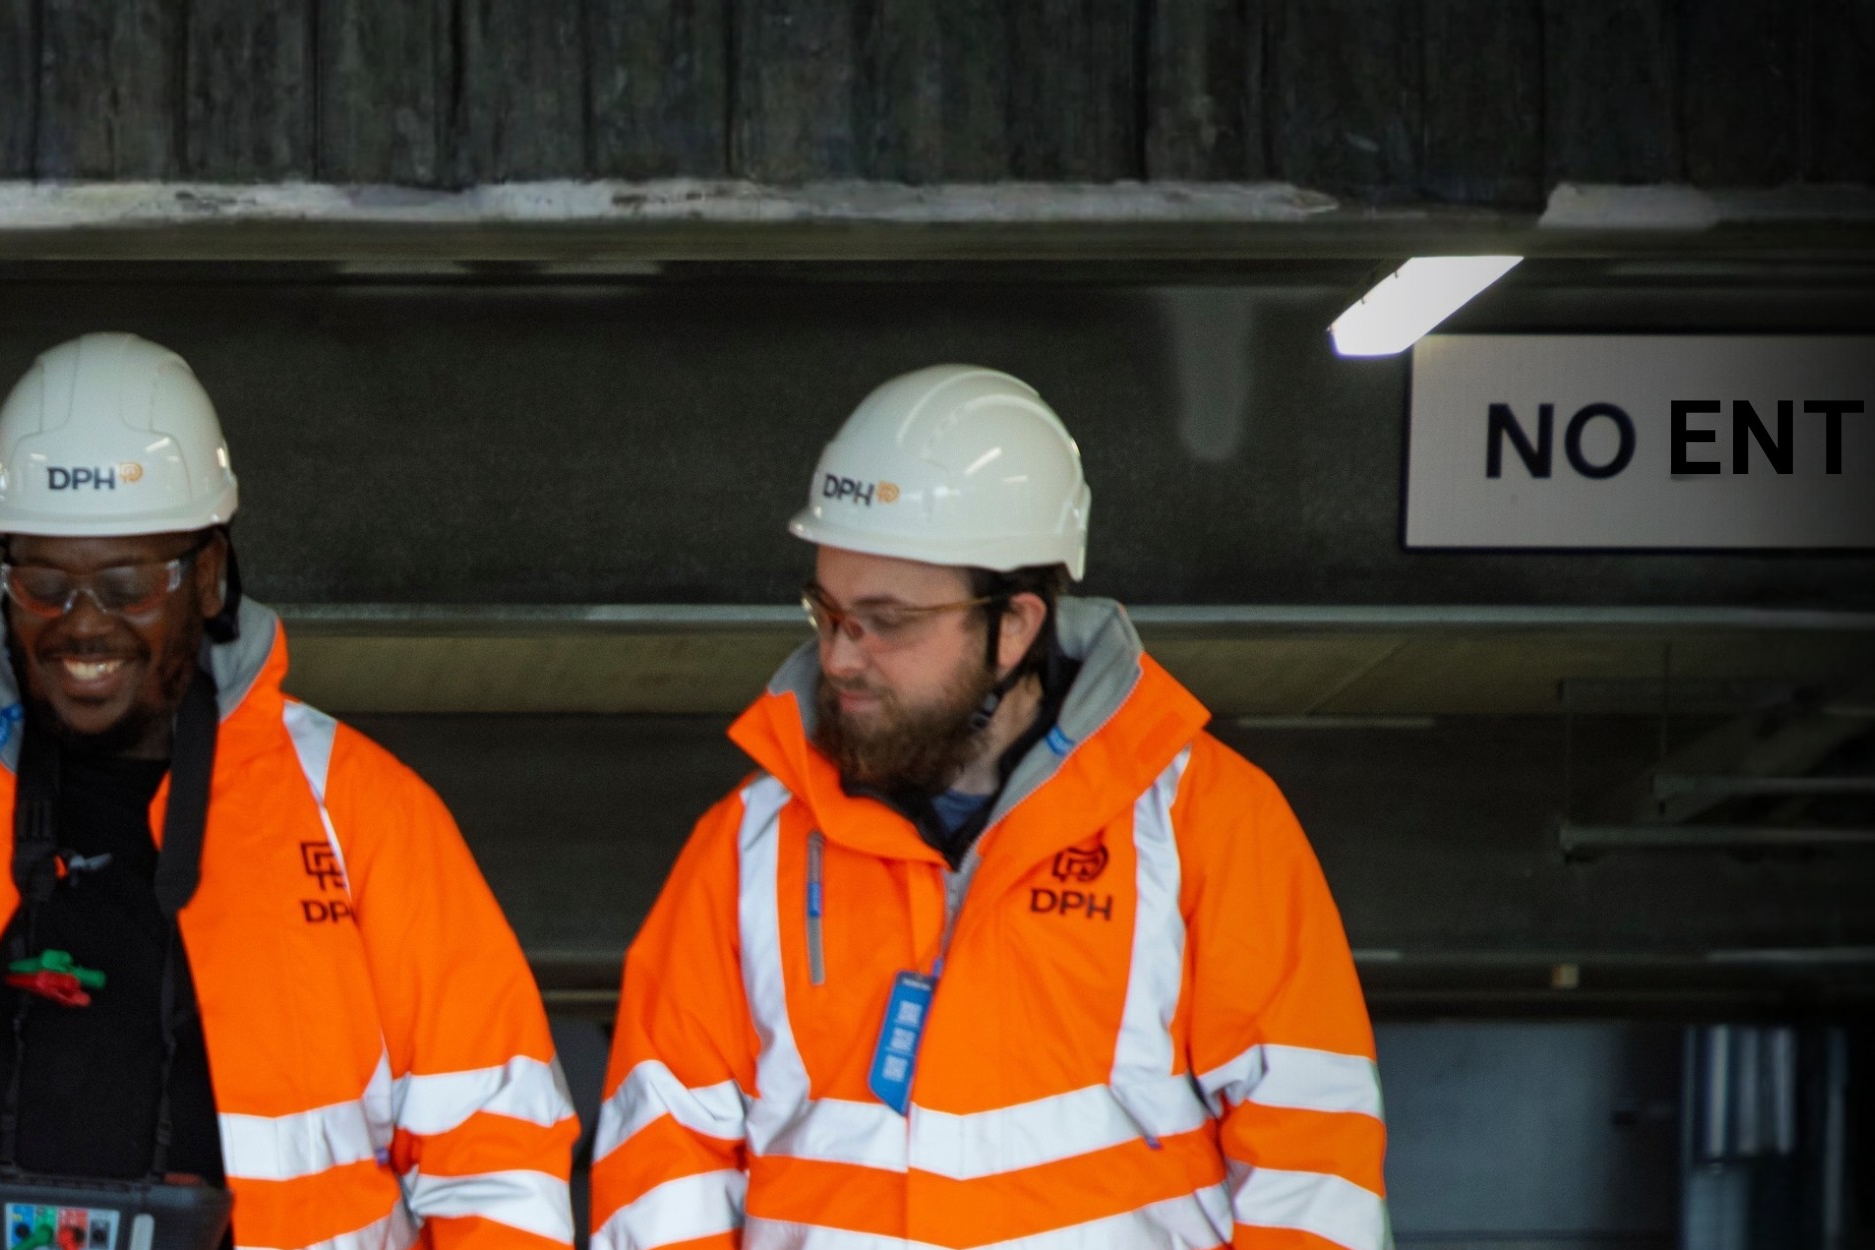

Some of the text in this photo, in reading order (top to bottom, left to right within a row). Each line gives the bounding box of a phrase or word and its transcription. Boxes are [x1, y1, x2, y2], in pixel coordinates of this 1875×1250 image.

[1486, 400, 1864, 479] NO ENT
[47, 466, 116, 490] DPH
[822, 472, 875, 506] DPH
[301, 899, 351, 923] DP
[1029, 887, 1113, 921] DPH
